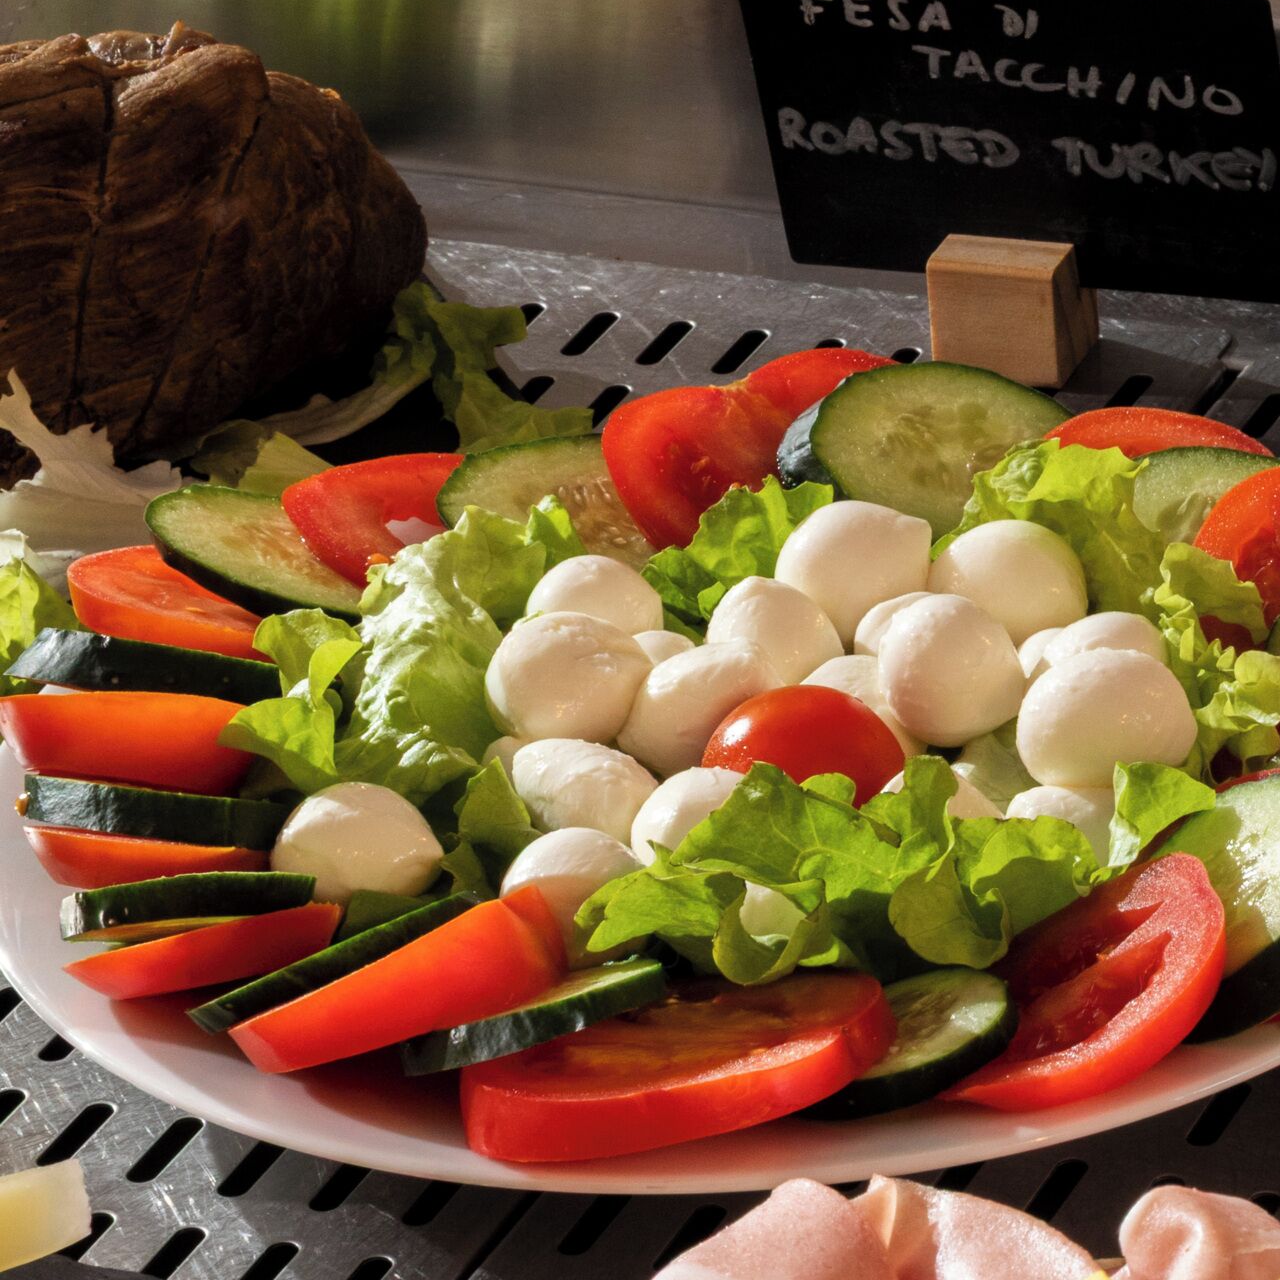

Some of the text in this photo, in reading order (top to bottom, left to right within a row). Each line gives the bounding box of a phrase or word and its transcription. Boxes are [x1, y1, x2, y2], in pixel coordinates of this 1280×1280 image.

[993, 4, 1040, 39] DI
[912, 45, 1244, 116] TACCHINO
[777, 106, 1020, 168] ROASTED
